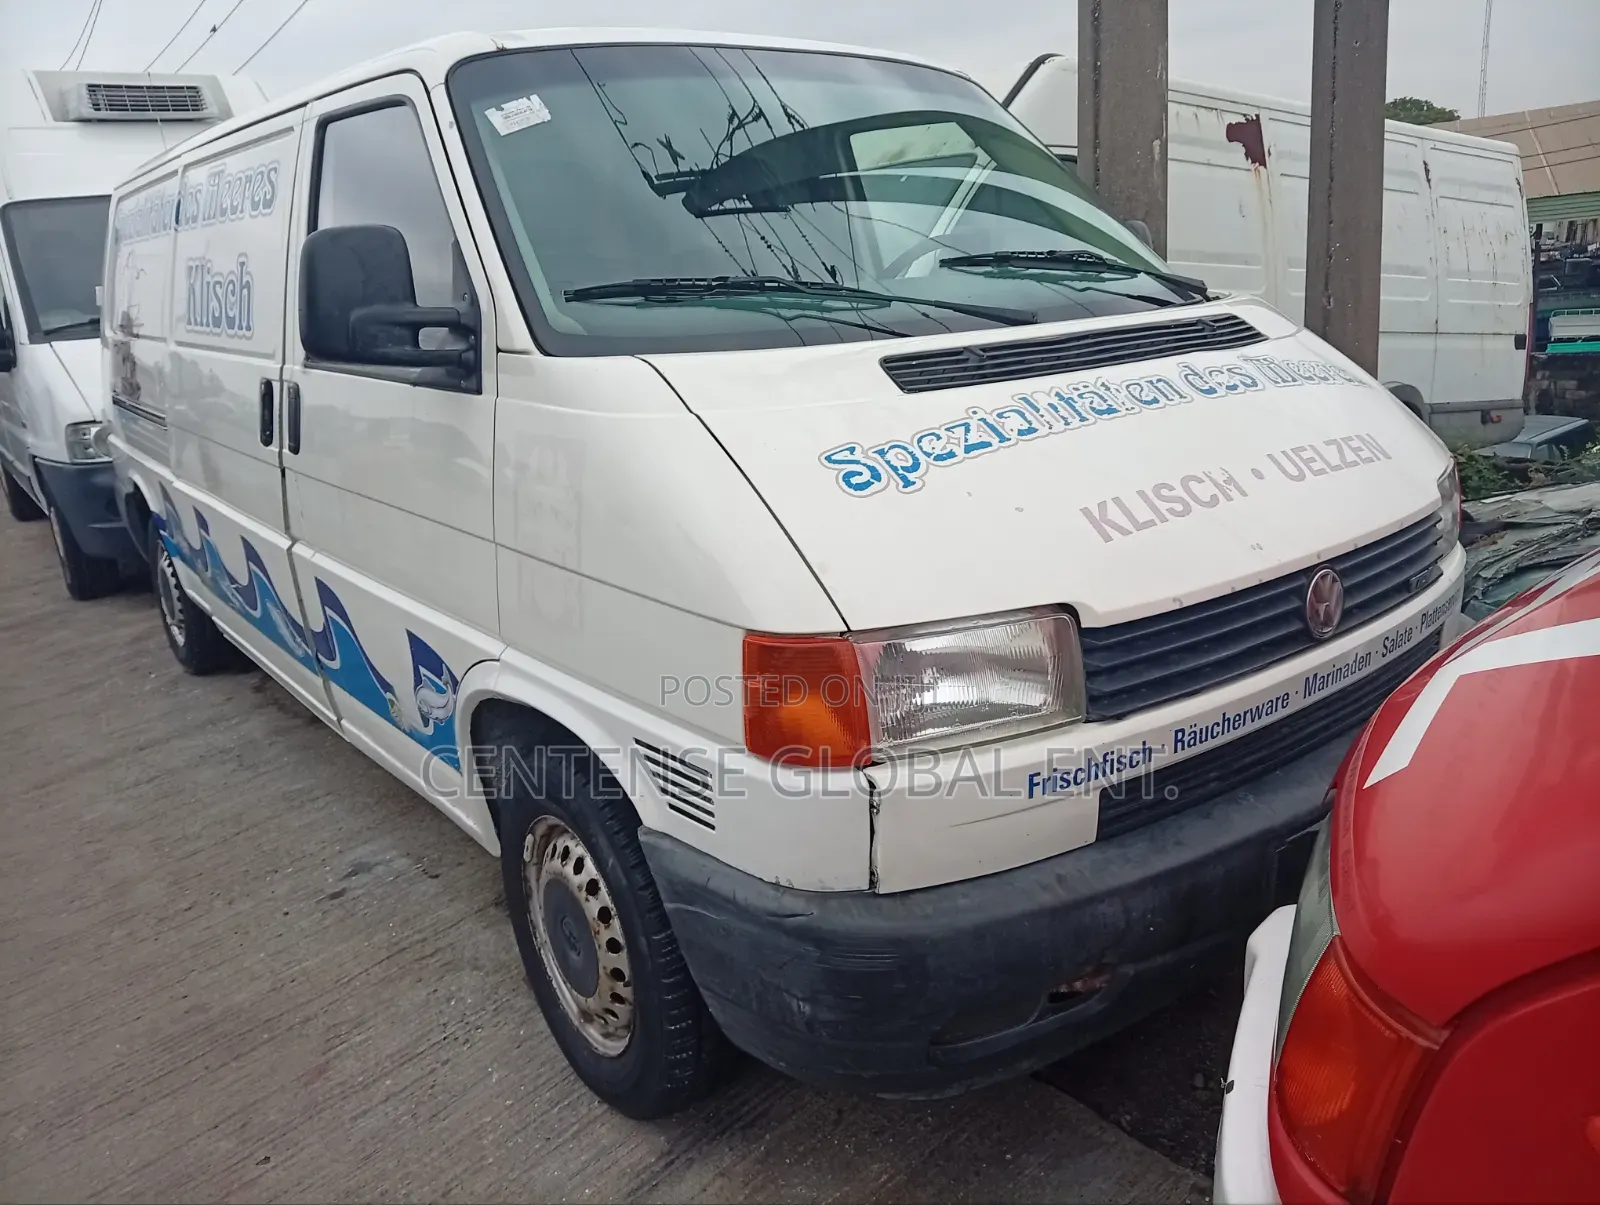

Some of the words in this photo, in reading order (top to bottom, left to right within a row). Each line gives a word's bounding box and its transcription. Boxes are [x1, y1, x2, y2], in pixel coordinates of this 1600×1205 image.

[202, 160, 280, 225] Meeres
[186, 253, 253, 340] Klisch
[819, 377, 1189, 498] Spezialitäten
[1177, 361, 1265, 399] des
[1081, 468, 1247, 544] KLISCH
[1265, 433, 1392, 484] UELZEN
[1028, 740, 1153, 799] Frischfisch
[1174, 693, 1290, 753] Räucherware
[1304, 651, 1372, 699] Marinaden
[1381, 626, 1413, 658] Salate
